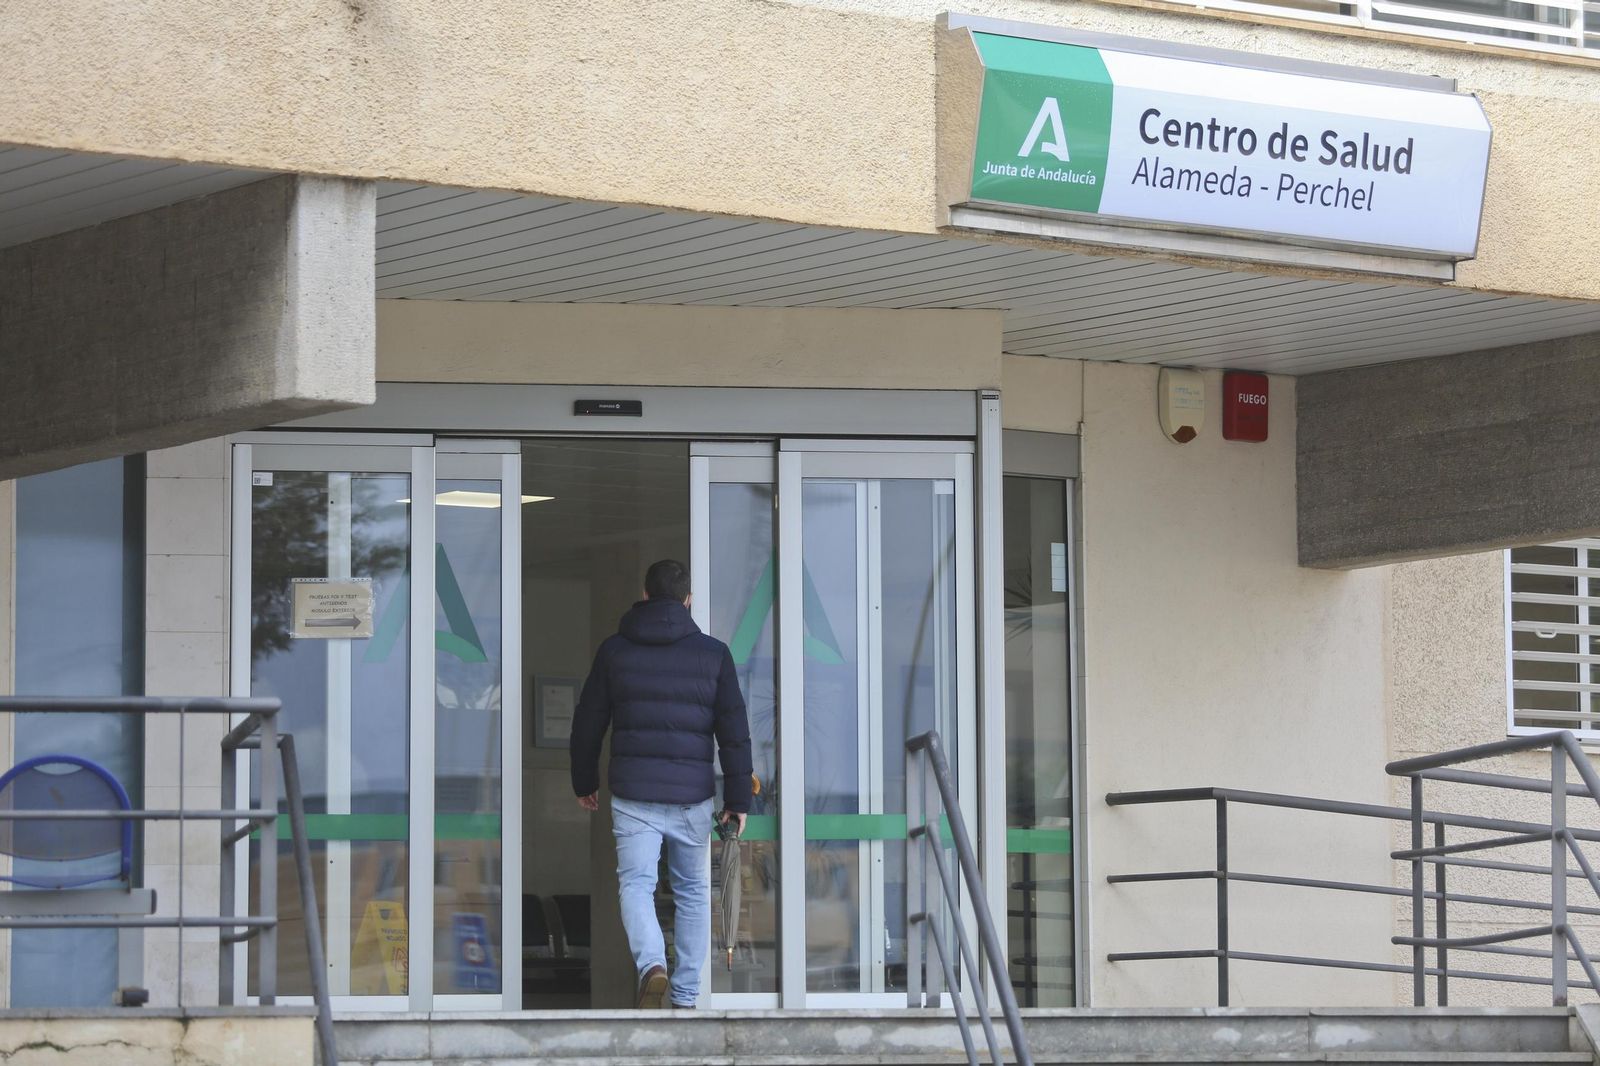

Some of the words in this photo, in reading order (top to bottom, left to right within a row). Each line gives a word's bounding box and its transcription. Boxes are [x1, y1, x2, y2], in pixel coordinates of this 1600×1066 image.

[1139, 107, 1258, 157] Centro
[1267, 122, 1309, 162] de
[1318, 129, 1415, 175] Salud
[982, 161, 1017, 177] Junta
[1020, 167, 1037, 178] de
[1038, 168, 1097, 185] Andalucía
[1132, 156, 1252, 198] Alameda
[1276, 173, 1375, 212] Perchel
[1238, 393, 1267, 406] FUEGO
